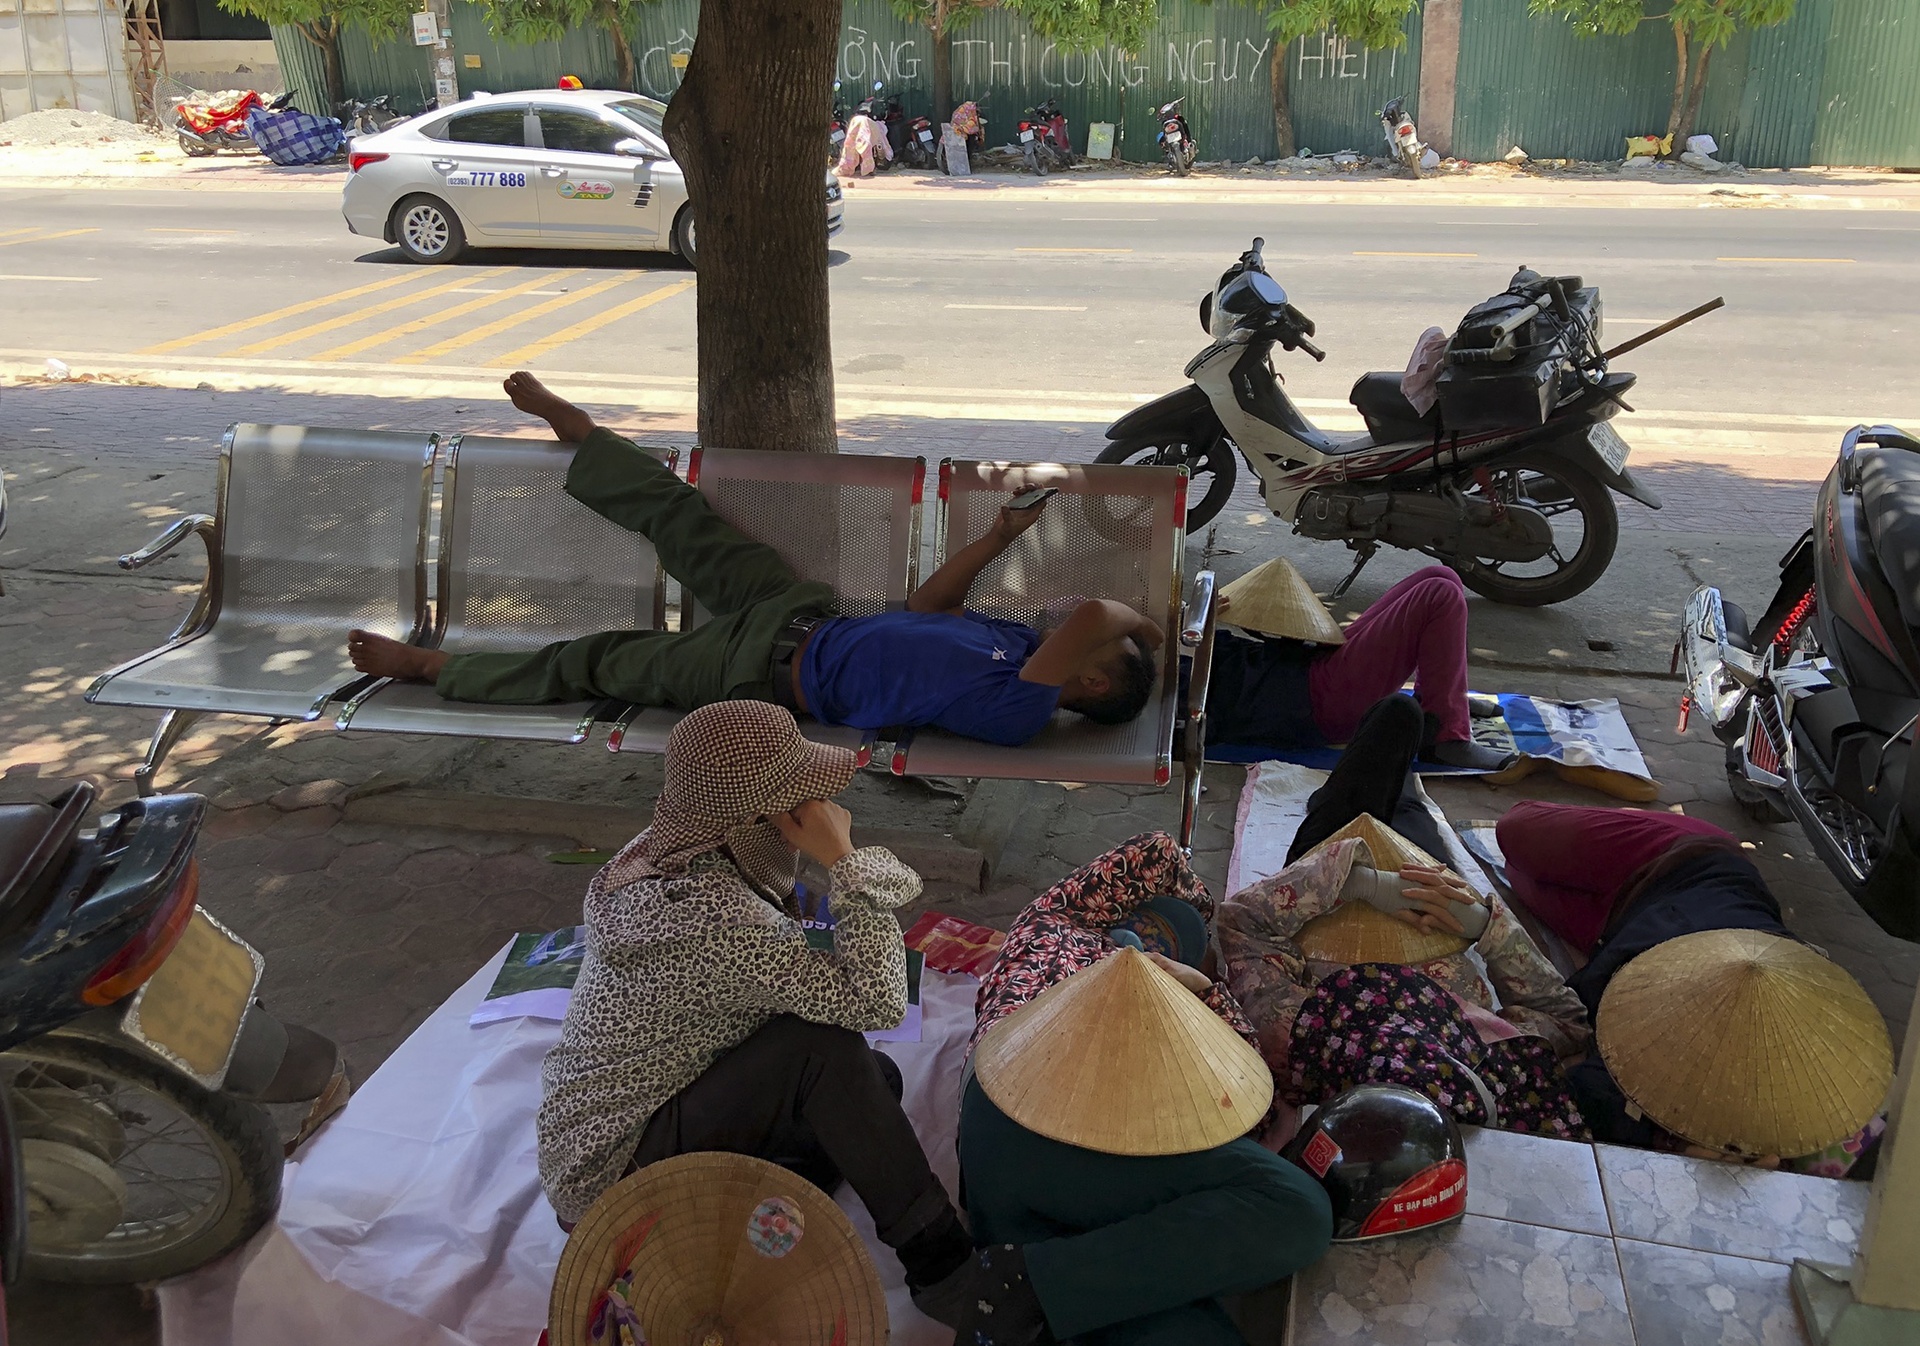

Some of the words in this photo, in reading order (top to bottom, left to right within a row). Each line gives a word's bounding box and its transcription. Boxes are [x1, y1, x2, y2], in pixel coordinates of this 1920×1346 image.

[1168, 37, 1271, 84] NGUY
[470, 172, 495, 186] 777
[499, 172, 526, 187] 888
[1393, 1202, 1403, 1211] XE
